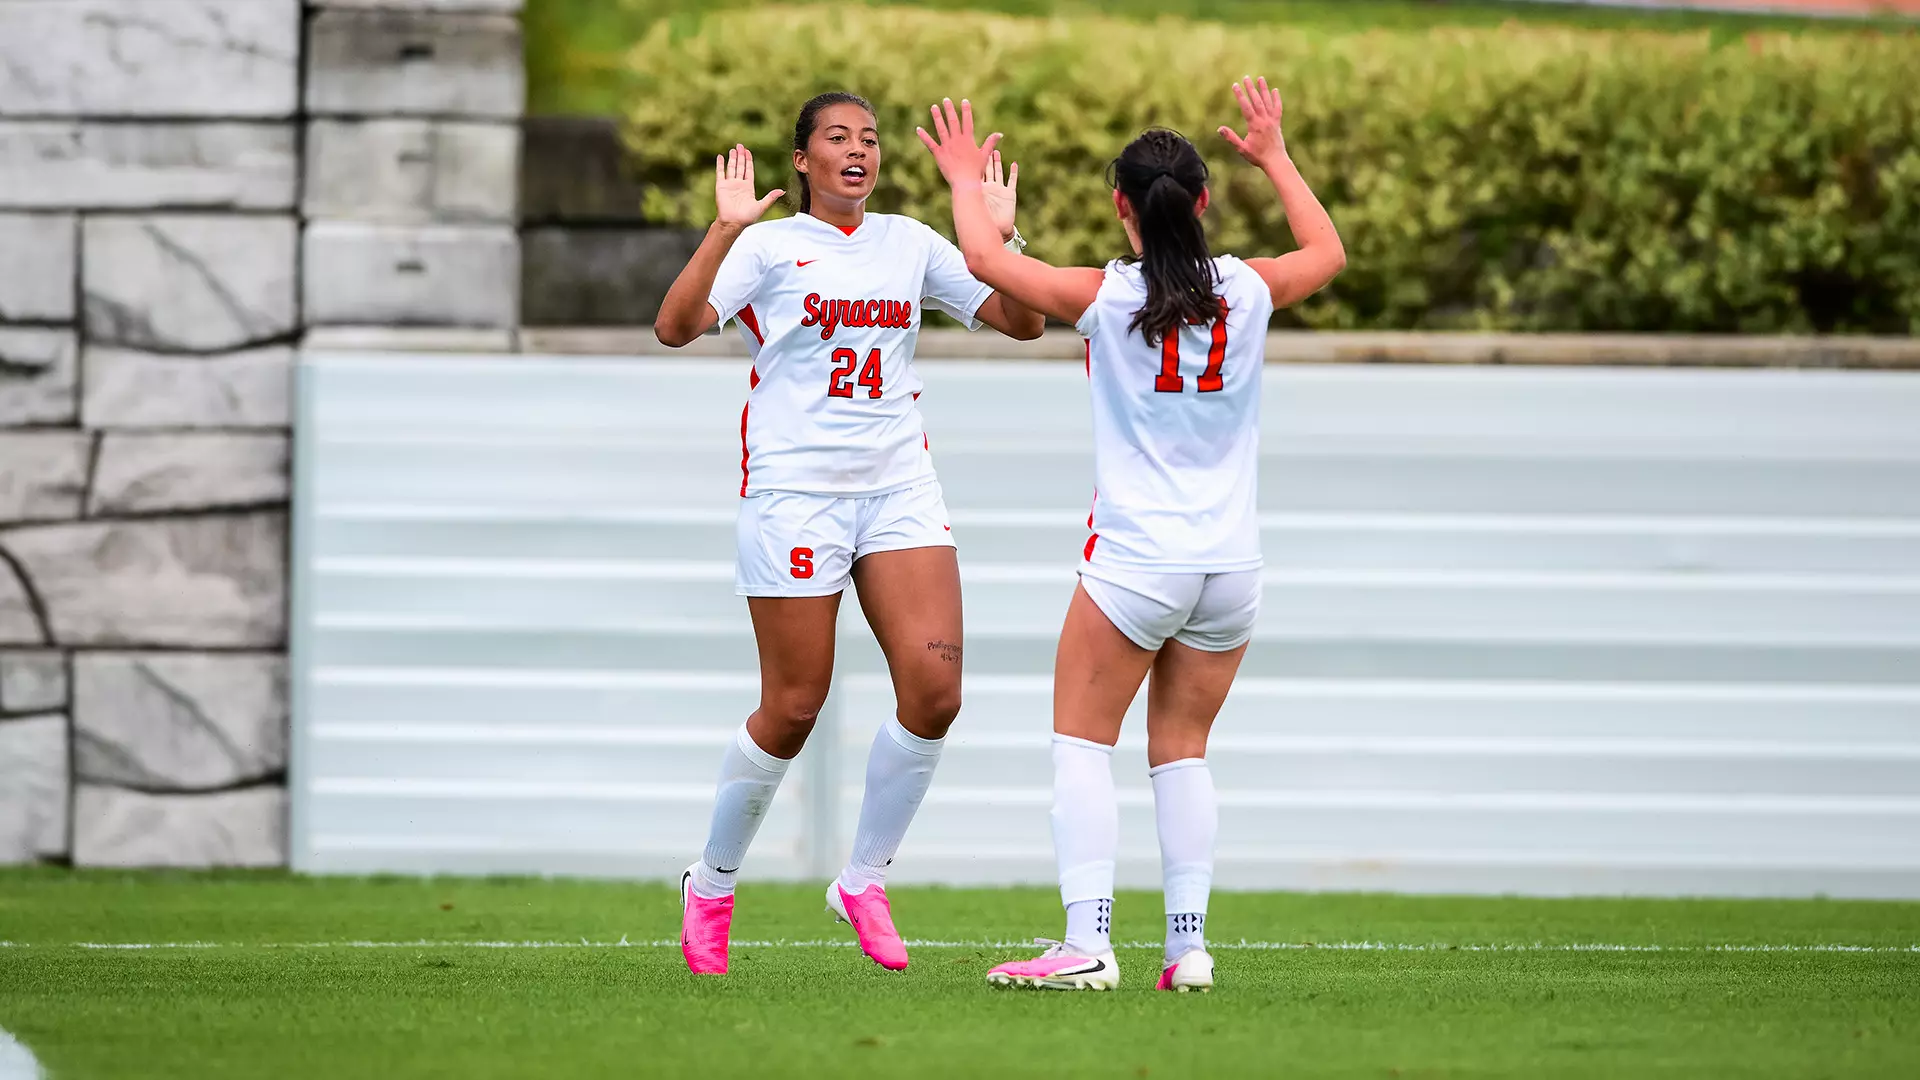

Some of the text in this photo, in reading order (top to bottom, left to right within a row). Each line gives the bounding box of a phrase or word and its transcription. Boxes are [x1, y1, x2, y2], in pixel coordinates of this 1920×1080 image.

[801, 293, 911, 340] Syracuse
[1154, 296, 1228, 393] 17
[828, 348, 882, 399] 24
[790, 547, 814, 579] S
